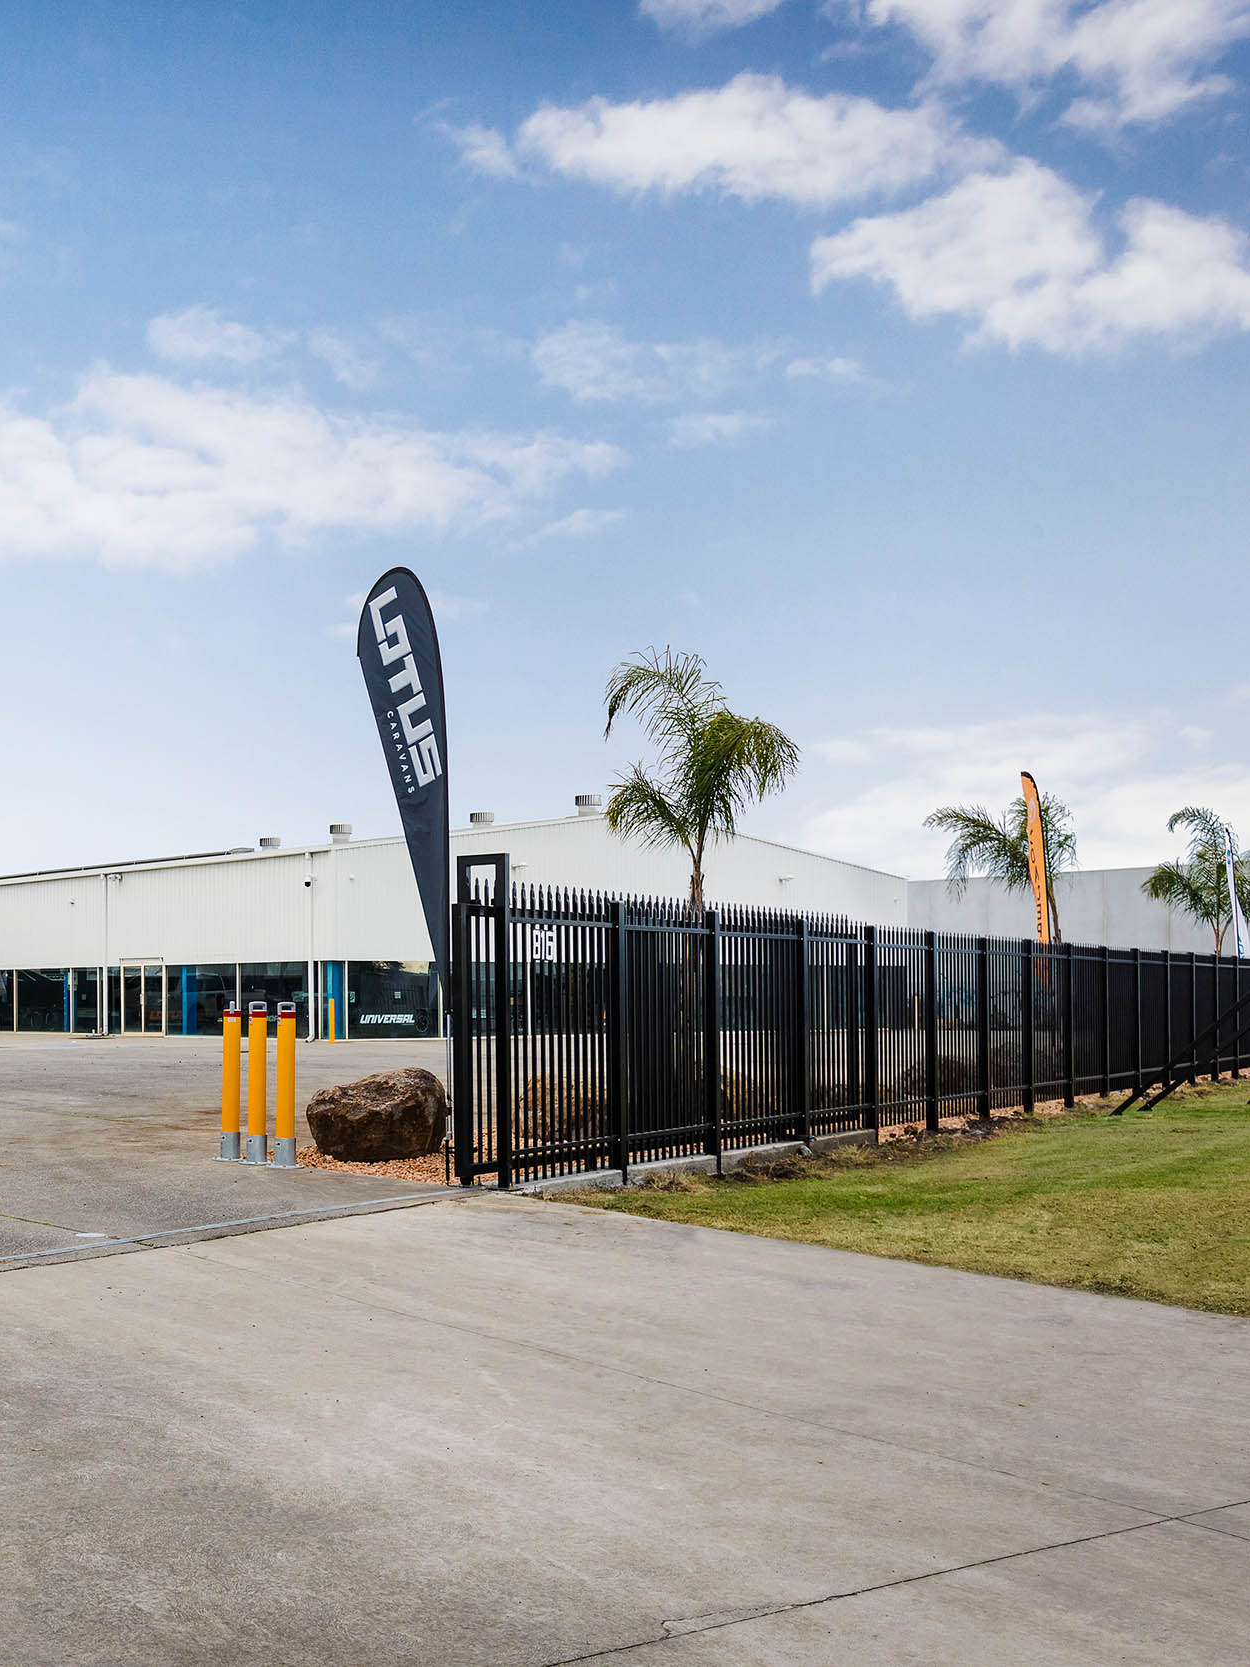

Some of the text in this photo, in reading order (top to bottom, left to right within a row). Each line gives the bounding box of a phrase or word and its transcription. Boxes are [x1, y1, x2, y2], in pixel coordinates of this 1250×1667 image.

[368, 586, 442, 787] LOTUS
[386, 710, 415, 793] CARAVANS
[533, 930, 554, 960] 816
[360, 1014, 415, 1024] UNIVERSAL
